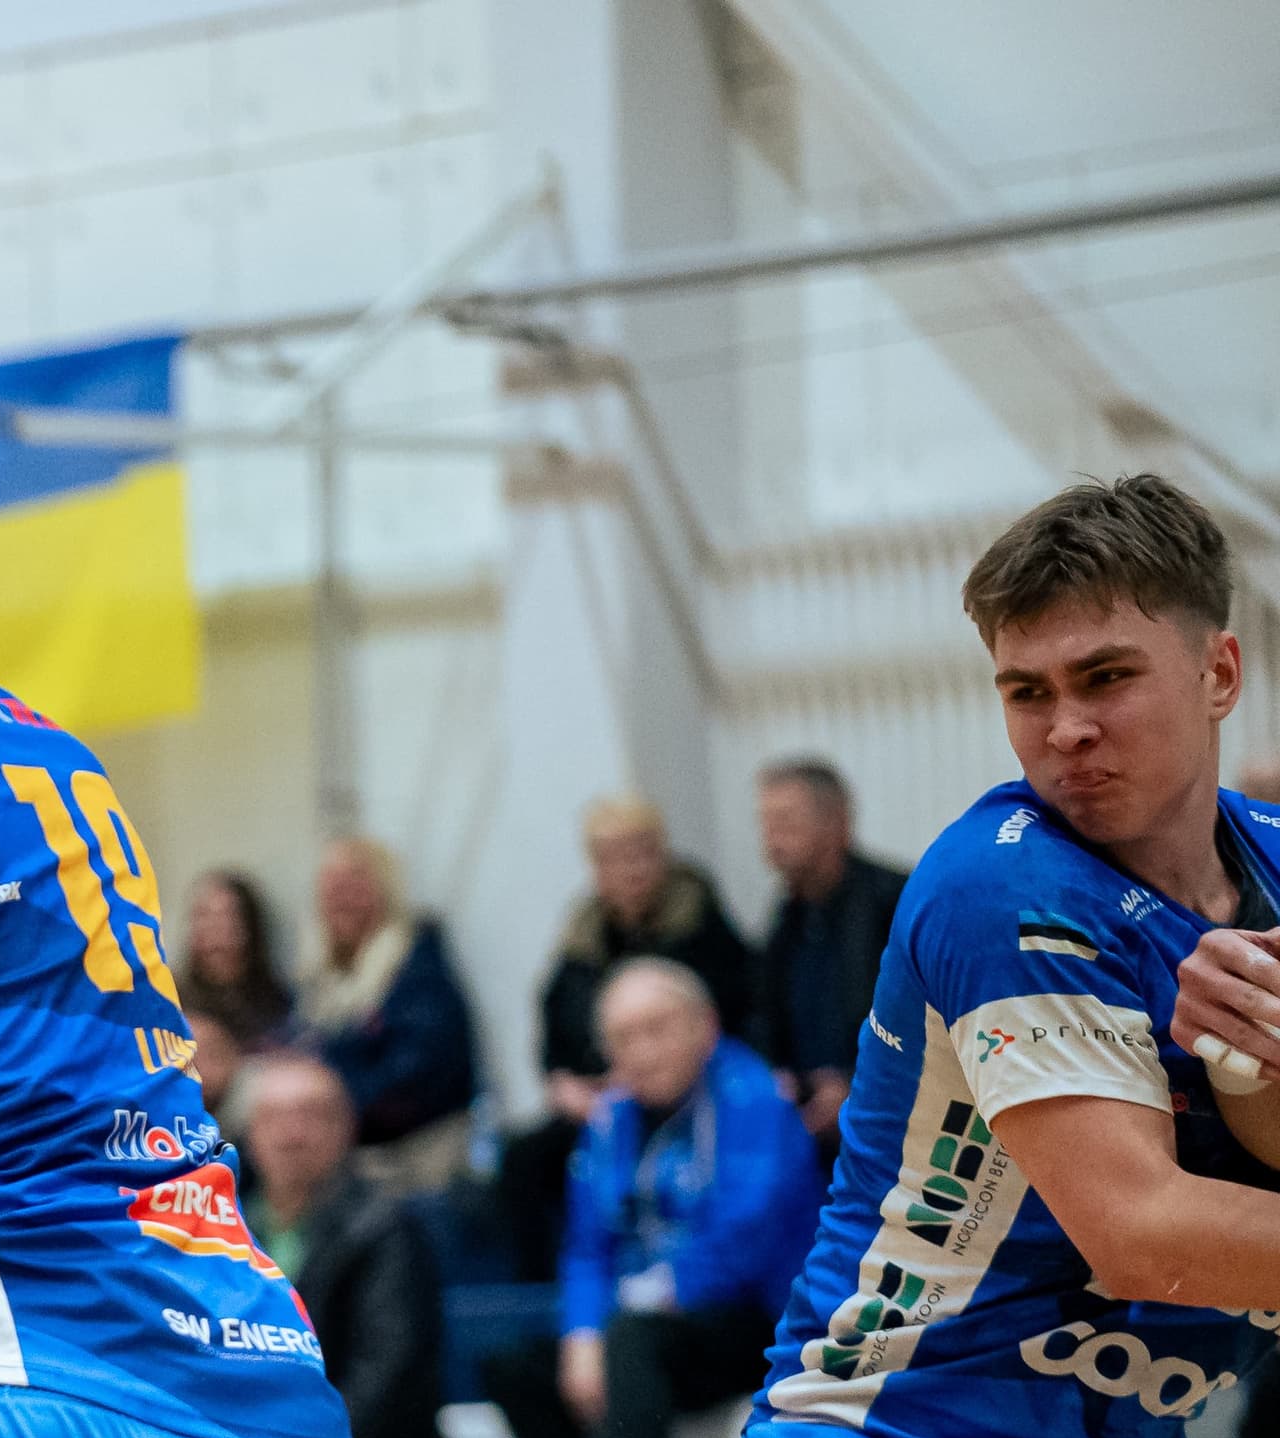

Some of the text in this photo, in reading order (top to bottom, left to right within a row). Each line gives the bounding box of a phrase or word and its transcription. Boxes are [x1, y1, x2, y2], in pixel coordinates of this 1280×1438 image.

[1, 764, 181, 1012] 19
[150, 1181, 237, 1225] CIRLE
[162, 1308, 210, 1344] SW
